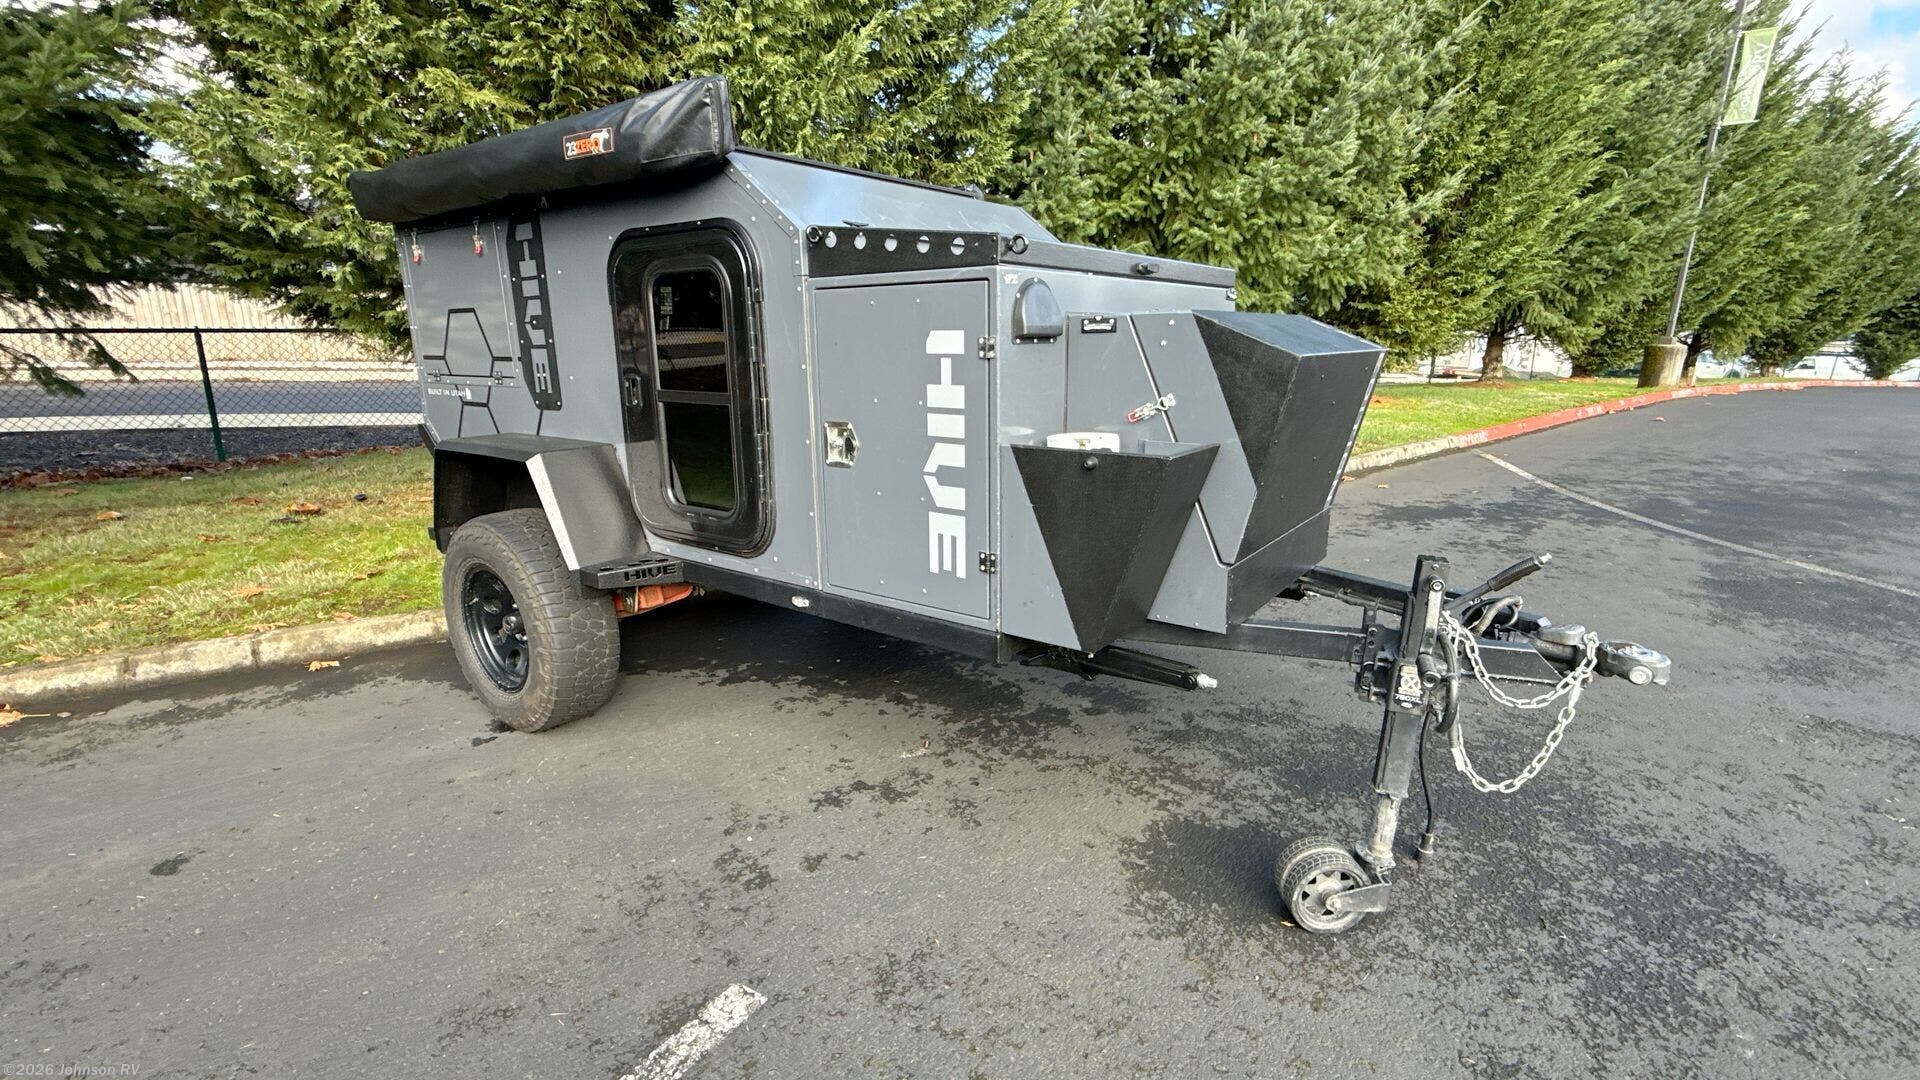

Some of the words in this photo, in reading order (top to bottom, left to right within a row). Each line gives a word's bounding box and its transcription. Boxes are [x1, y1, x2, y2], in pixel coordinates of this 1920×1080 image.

[514, 222, 553, 393] HIVE
[923, 329, 966, 579] HIVE
[624, 564, 676, 581] HIVE
